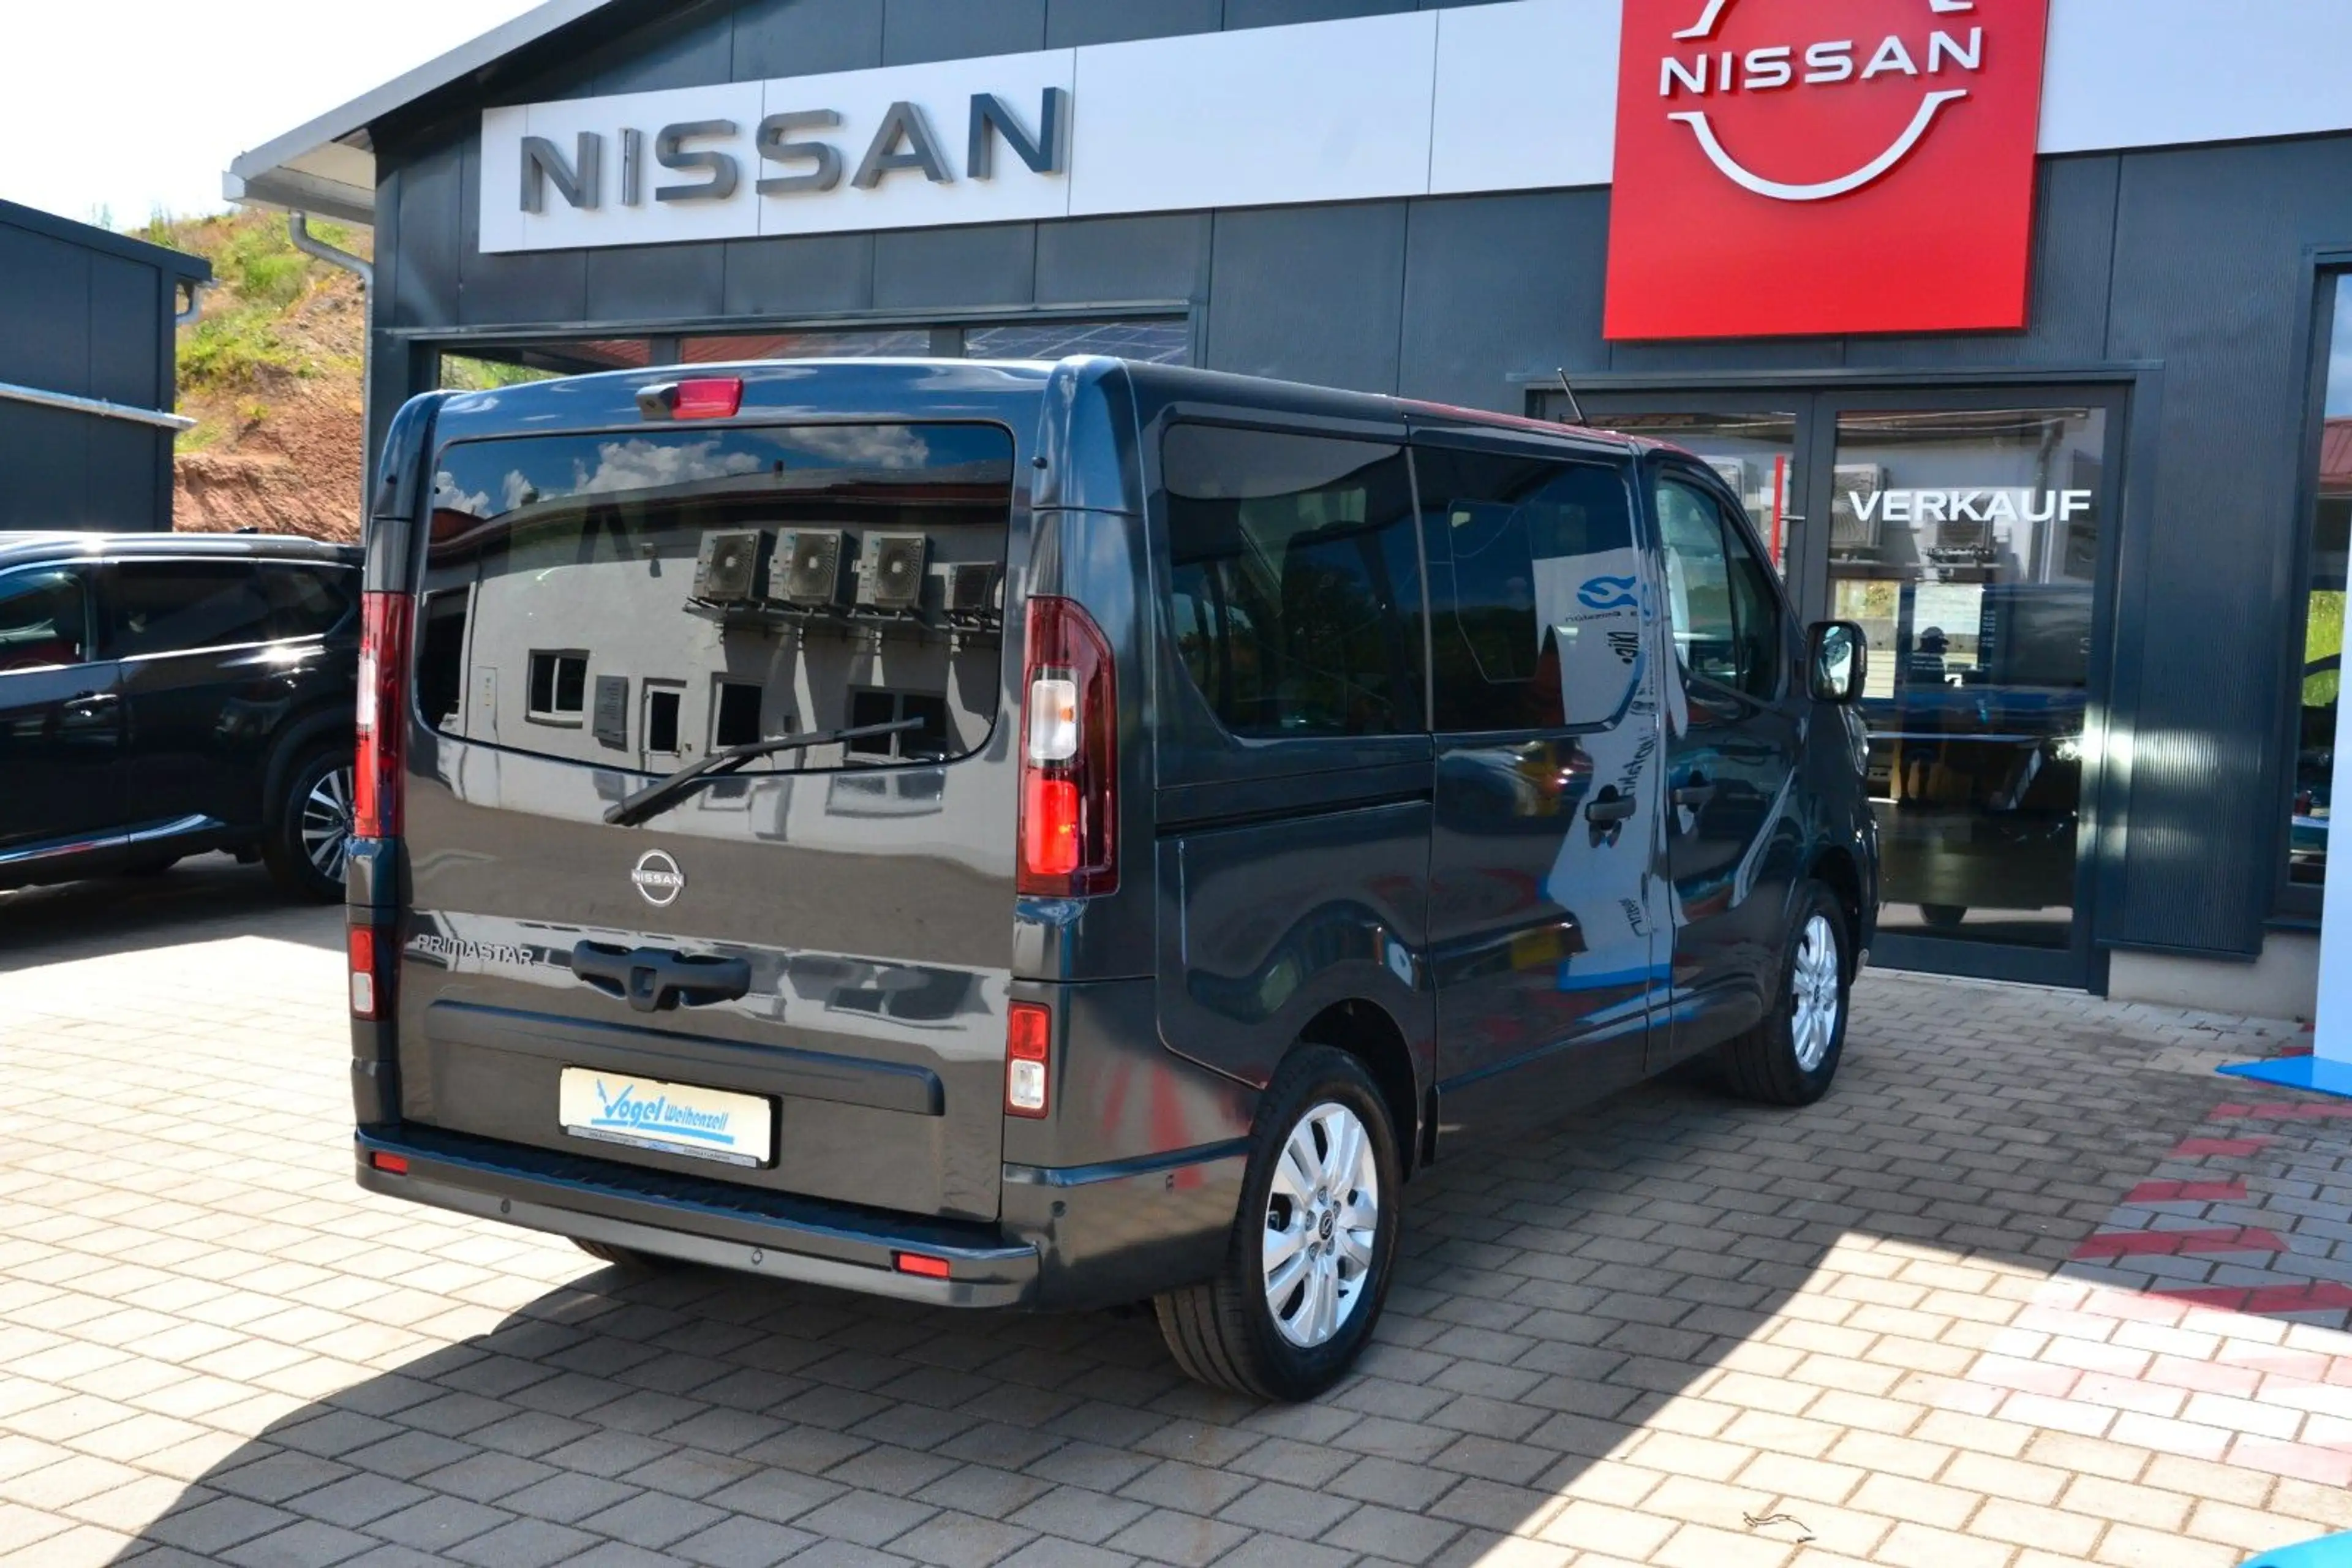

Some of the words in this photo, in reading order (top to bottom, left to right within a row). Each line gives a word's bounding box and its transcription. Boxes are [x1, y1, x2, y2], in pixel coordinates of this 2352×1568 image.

[1659, 26, 1982, 96] NISSAN
[520, 86, 1067, 214] NISSAN
[1849, 489, 2092, 521] VERKAUF
[631, 869, 685, 887] NISSAN
[417, 933, 535, 967] PRIMASTAR
[595, 1079, 666, 1128] Vogel
[663, 1104, 729, 1131] Weihenzell
